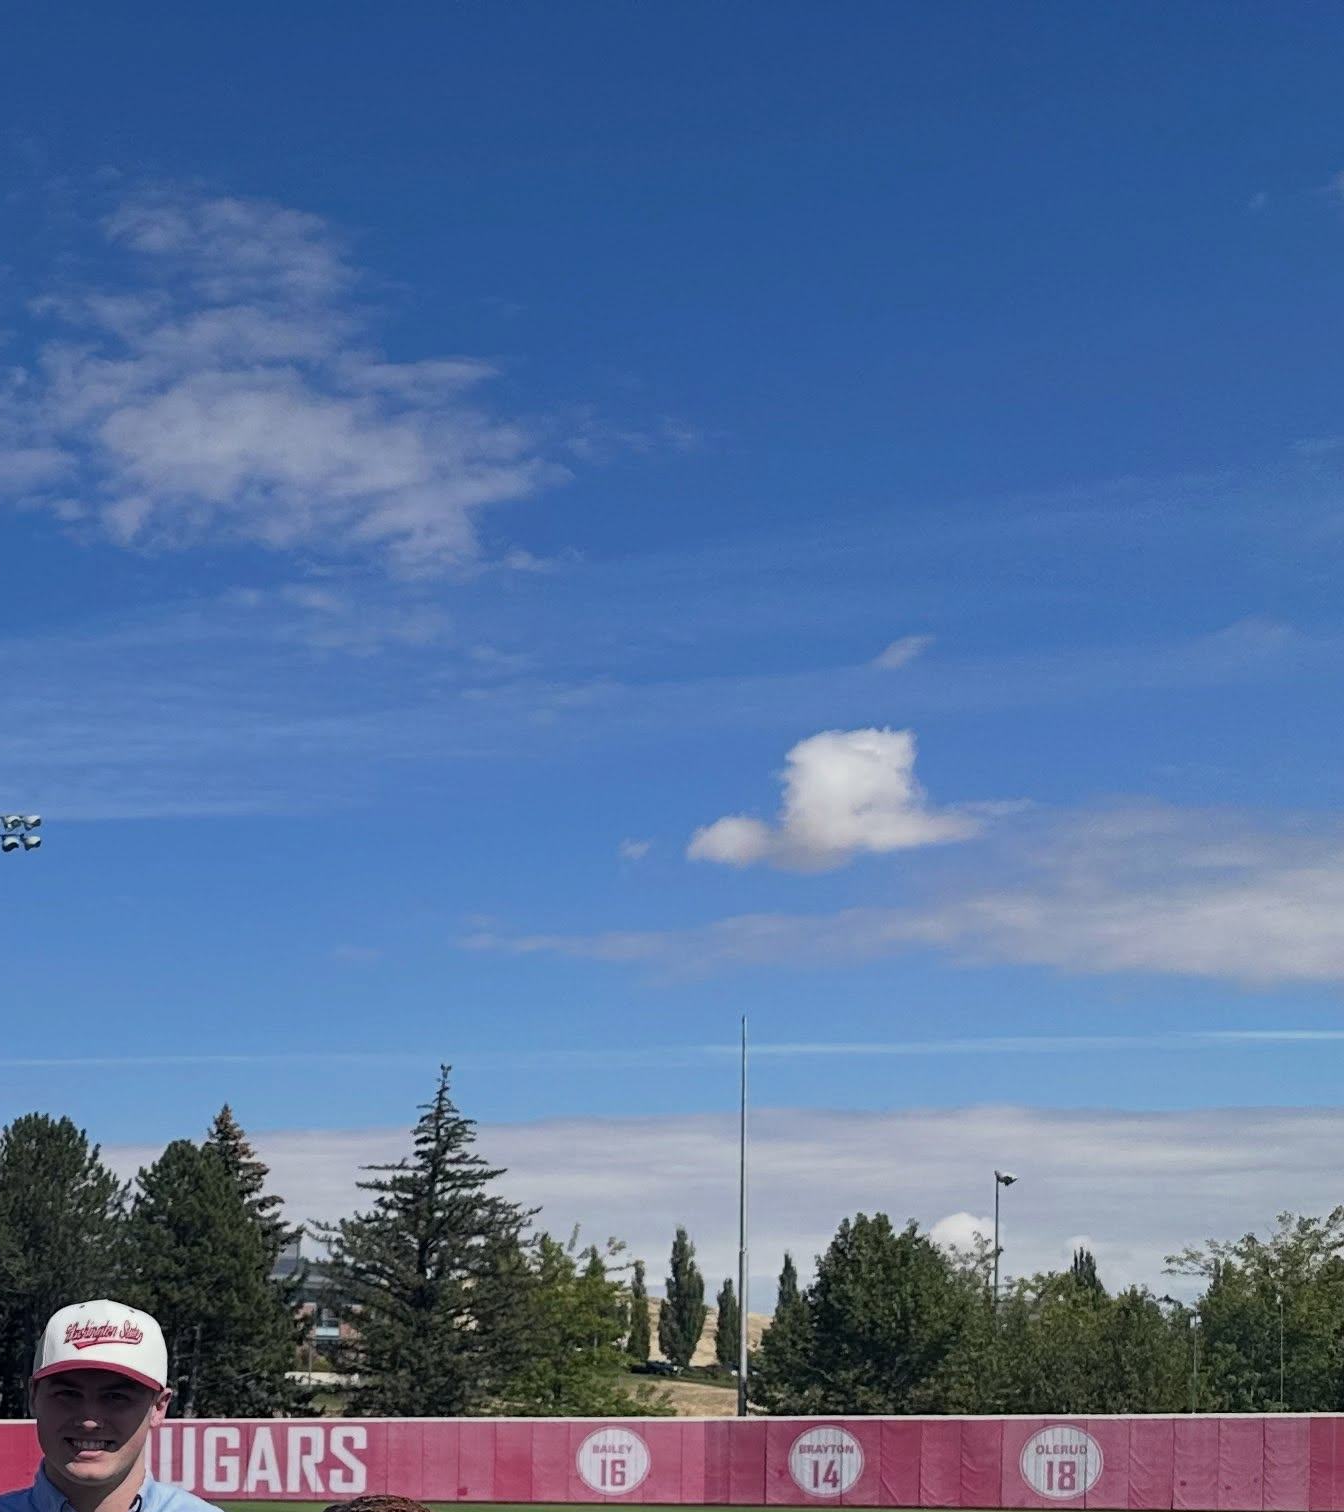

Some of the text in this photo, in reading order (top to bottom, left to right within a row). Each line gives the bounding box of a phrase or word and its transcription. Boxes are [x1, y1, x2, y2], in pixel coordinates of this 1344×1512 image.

[145, 1426, 368, 1494] UGARS
[592, 1444, 633, 1455] BAILEY
[798, 1444, 854, 1455] BRAYTON
[1035, 1444, 1088, 1455] OLERUD
[600, 1459, 626, 1486] 16
[812, 1459, 840, 1489] 14
[1046, 1460, 1076, 1491] 18
